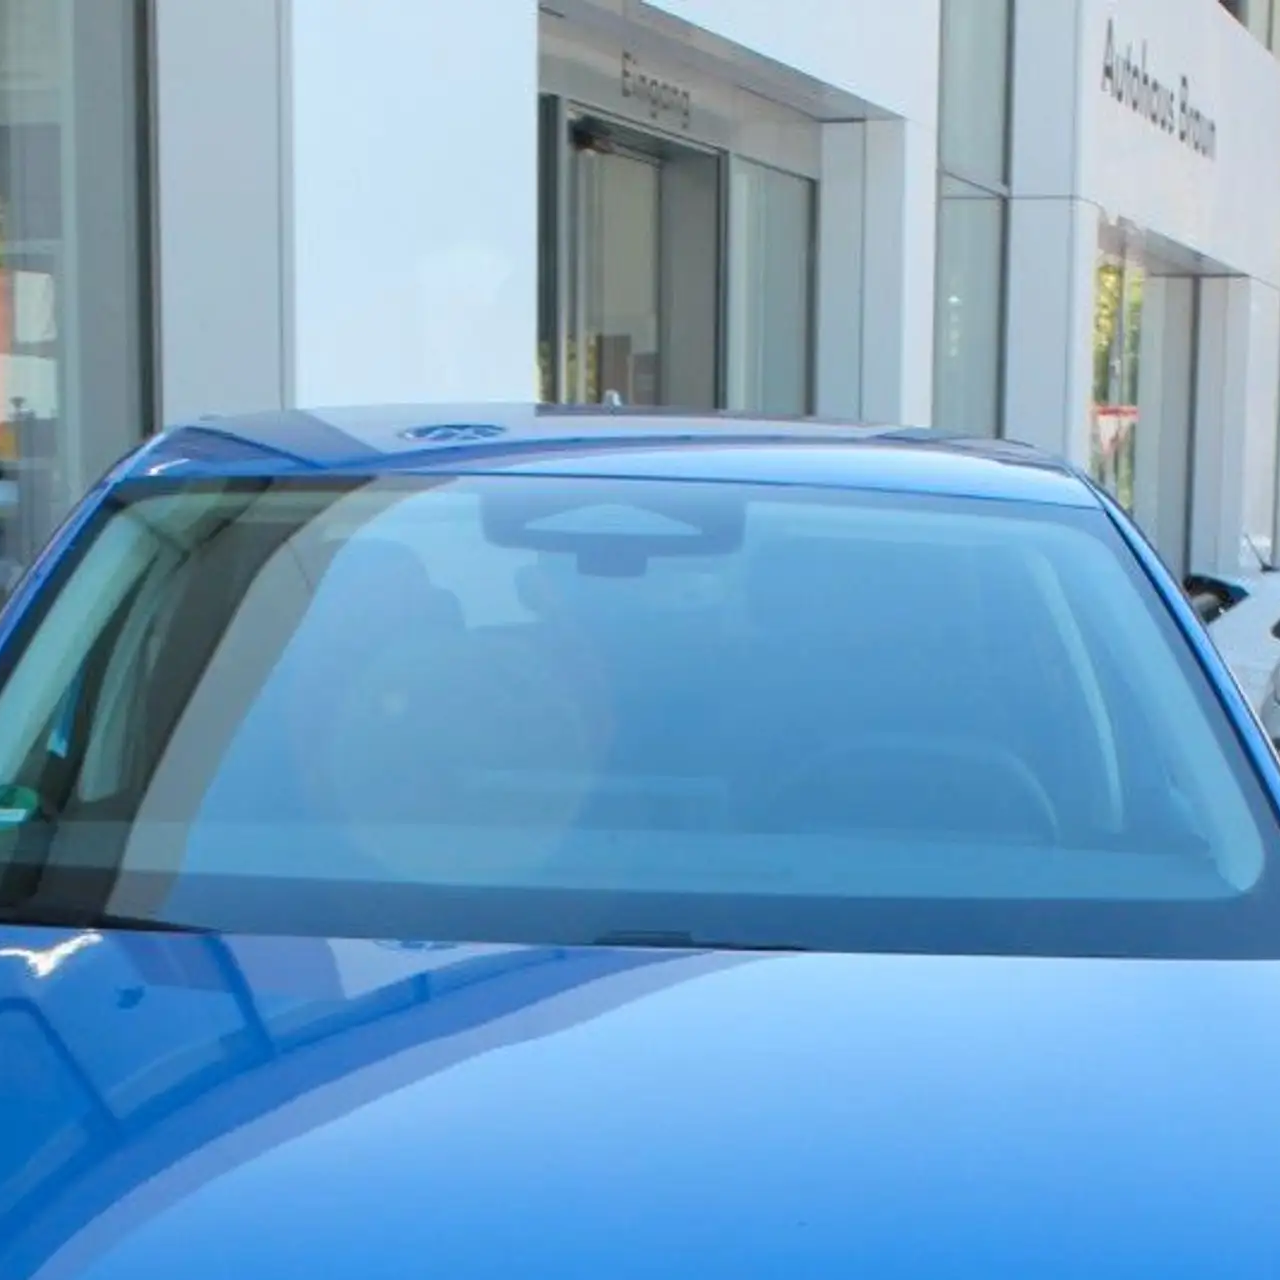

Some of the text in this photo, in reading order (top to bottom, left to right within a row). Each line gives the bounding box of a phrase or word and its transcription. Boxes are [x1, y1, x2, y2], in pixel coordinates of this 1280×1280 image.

[621, 49, 691, 130] Eingang
[1101, 17, 1217, 163] Autohaus Braun
